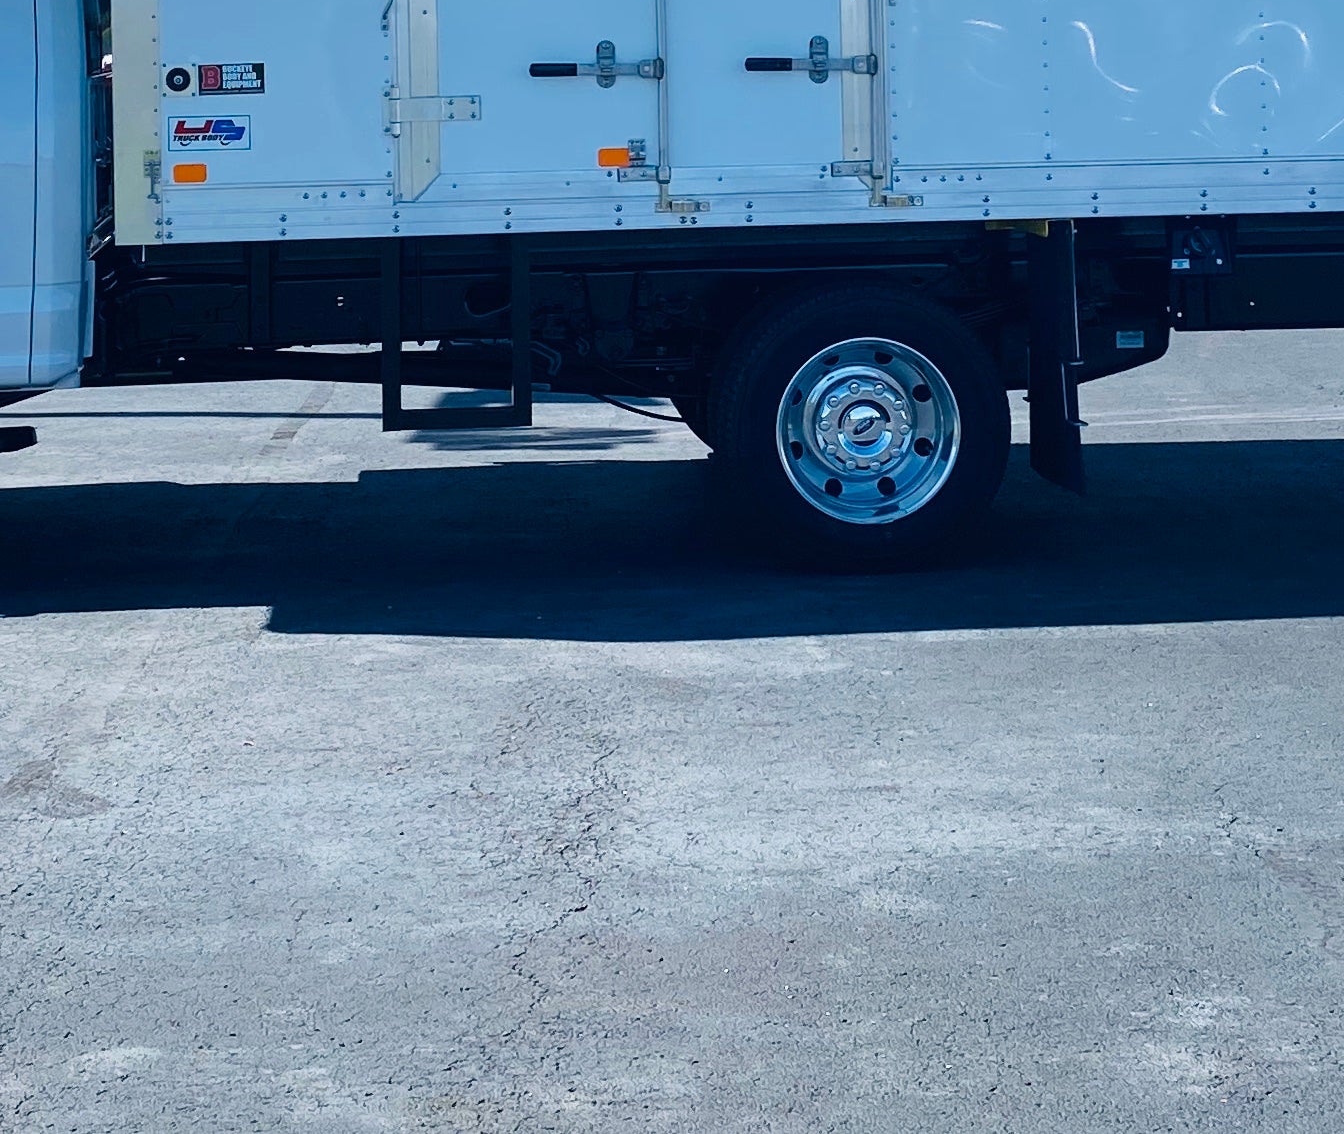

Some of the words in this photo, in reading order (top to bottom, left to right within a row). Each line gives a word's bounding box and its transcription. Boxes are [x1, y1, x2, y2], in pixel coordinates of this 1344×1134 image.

[173, 119, 246, 141] US
[173, 134, 201, 142] TRUCK
[201, 134, 225, 142] BODY
